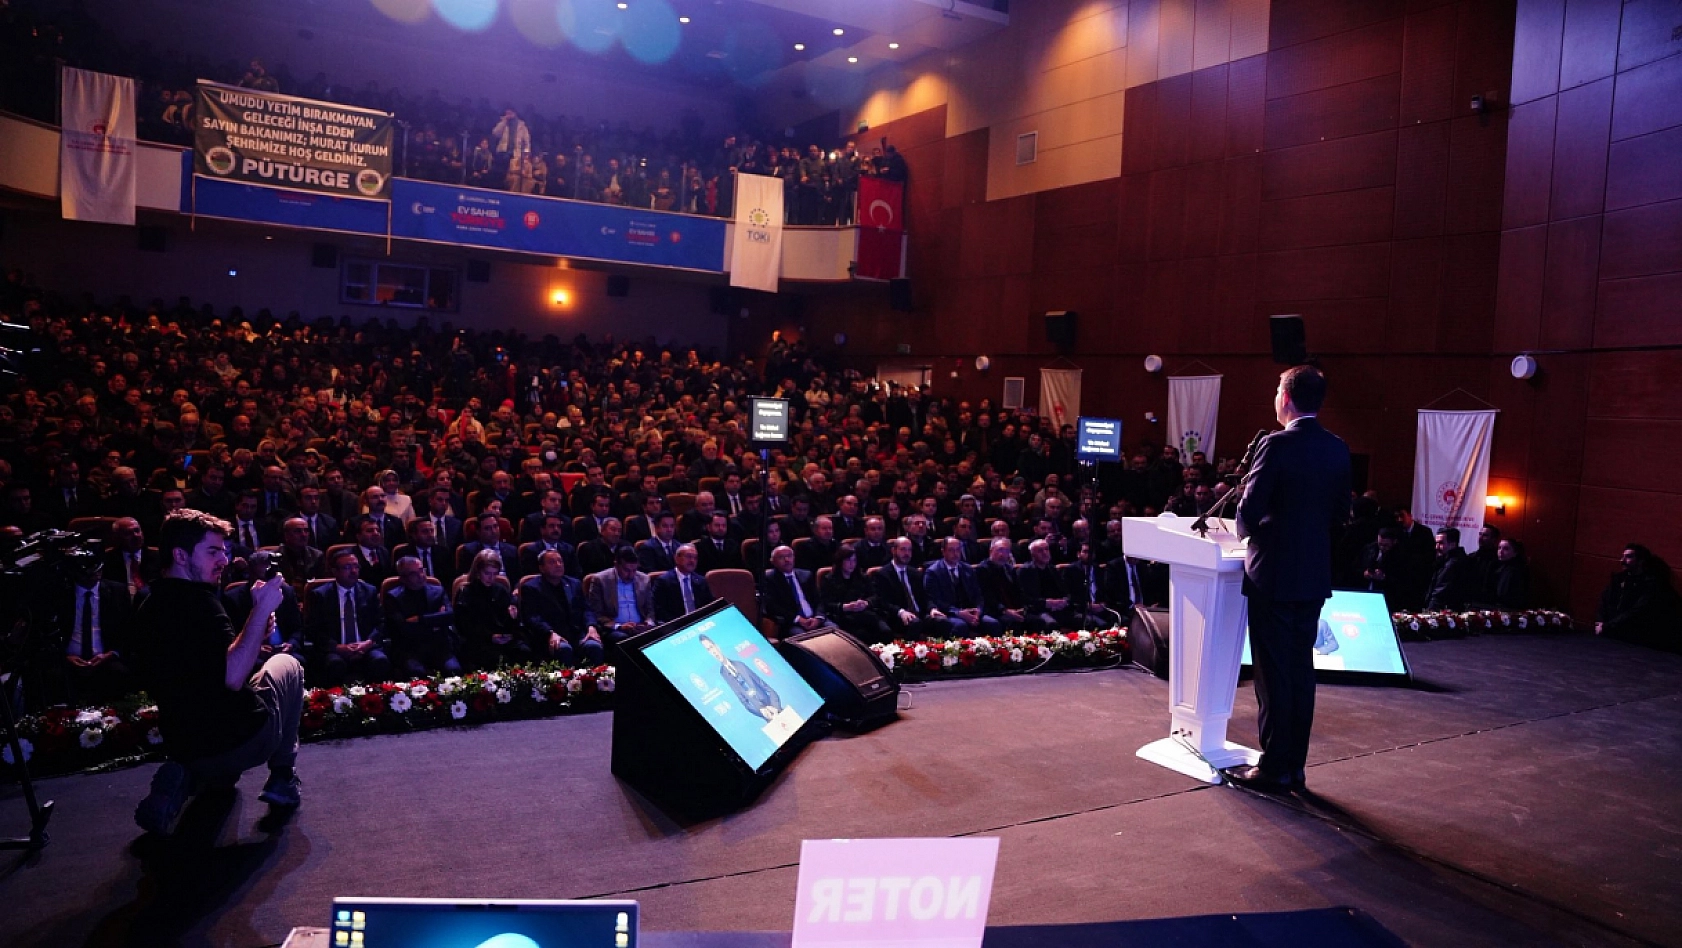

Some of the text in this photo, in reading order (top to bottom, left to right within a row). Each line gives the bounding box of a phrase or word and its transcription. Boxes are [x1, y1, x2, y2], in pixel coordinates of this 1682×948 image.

[220, 91, 265, 110] UMUDU
[267, 98, 301, 116] YETİM
[203, 117, 239, 133] SAYIN
[309, 135, 348, 151] MURAT
[349, 142, 388, 157] KURUM
[242, 111, 355, 139] GELECEĞİ İNŞA EDEN
[226, 134, 287, 156] ŞEHRİMİZE
[288, 146, 312, 162] HOŞ
[242, 156, 351, 189] PÜTÜRGE
